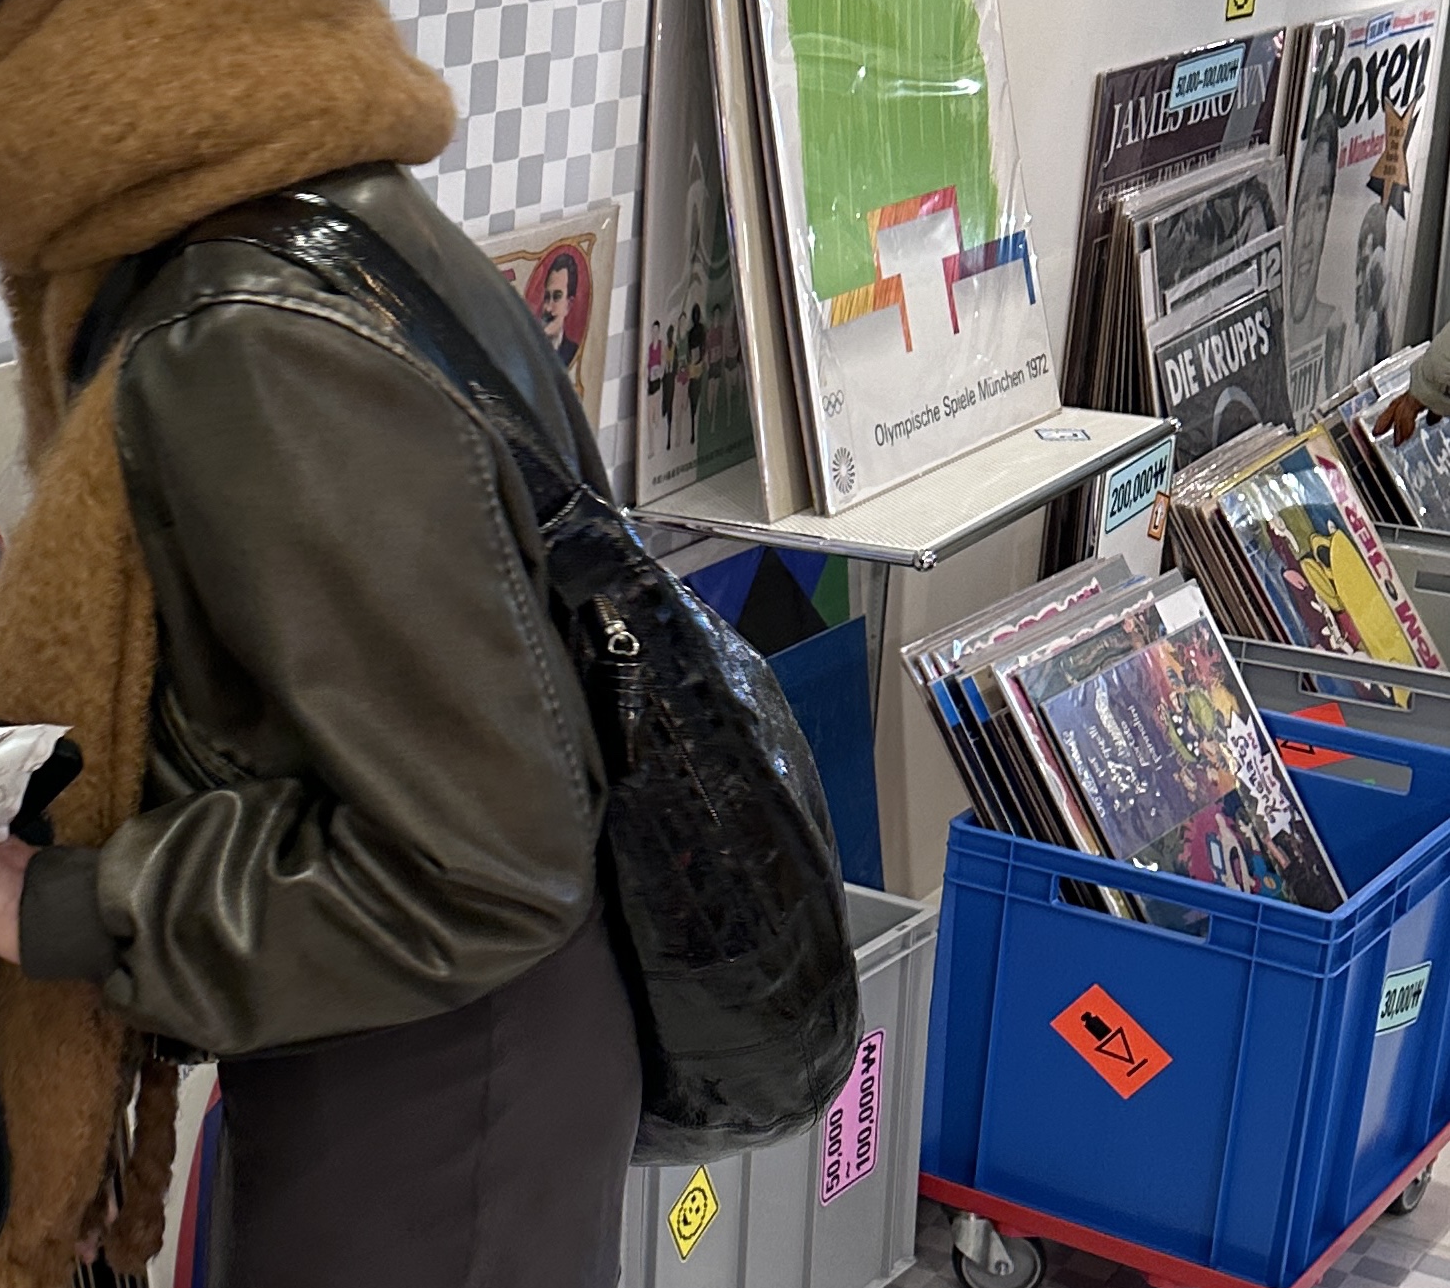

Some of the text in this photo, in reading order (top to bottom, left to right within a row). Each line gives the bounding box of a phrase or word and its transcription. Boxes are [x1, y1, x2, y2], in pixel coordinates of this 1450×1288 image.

[1301, 25, 1431, 140] Boxen
[1103, 90, 1184, 168] JAMES
[874, 352, 1049, 447] Olympische Spiele München 1972
[1165, 349, 1199, 406] DIE
[1199, 310, 1270, 388] KRUPPS
[1110, 461, 1167, 518] 200,000₩
[826, 1108, 844, 1194] 50,000
